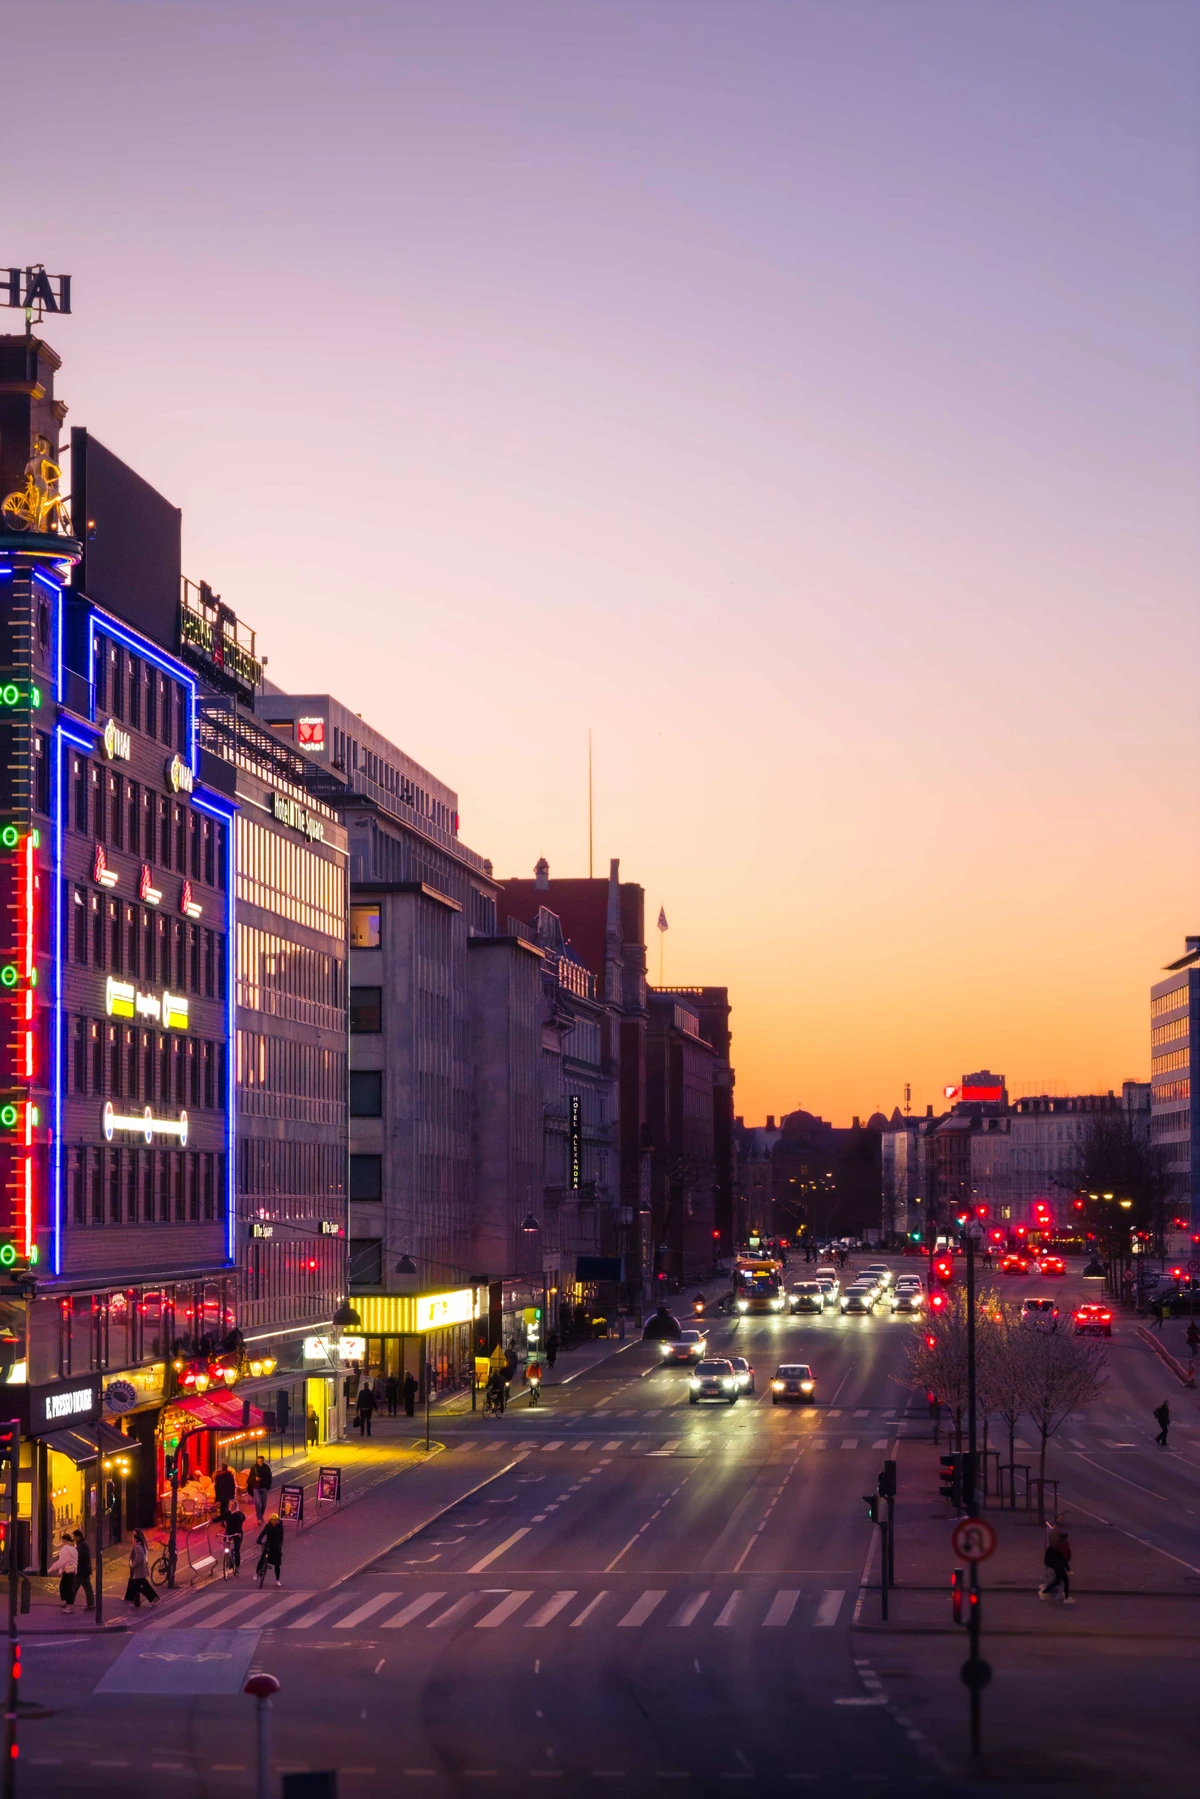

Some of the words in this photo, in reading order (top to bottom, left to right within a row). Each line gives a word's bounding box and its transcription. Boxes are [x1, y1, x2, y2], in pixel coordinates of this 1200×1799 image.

[274, 792, 290, 825] Hotel
[294, 803, 305, 832] The
[306, 810, 324, 843] Square
[1, 966, 17, 986] 0
[46, 1392, 73, 1420] EPRESSO
